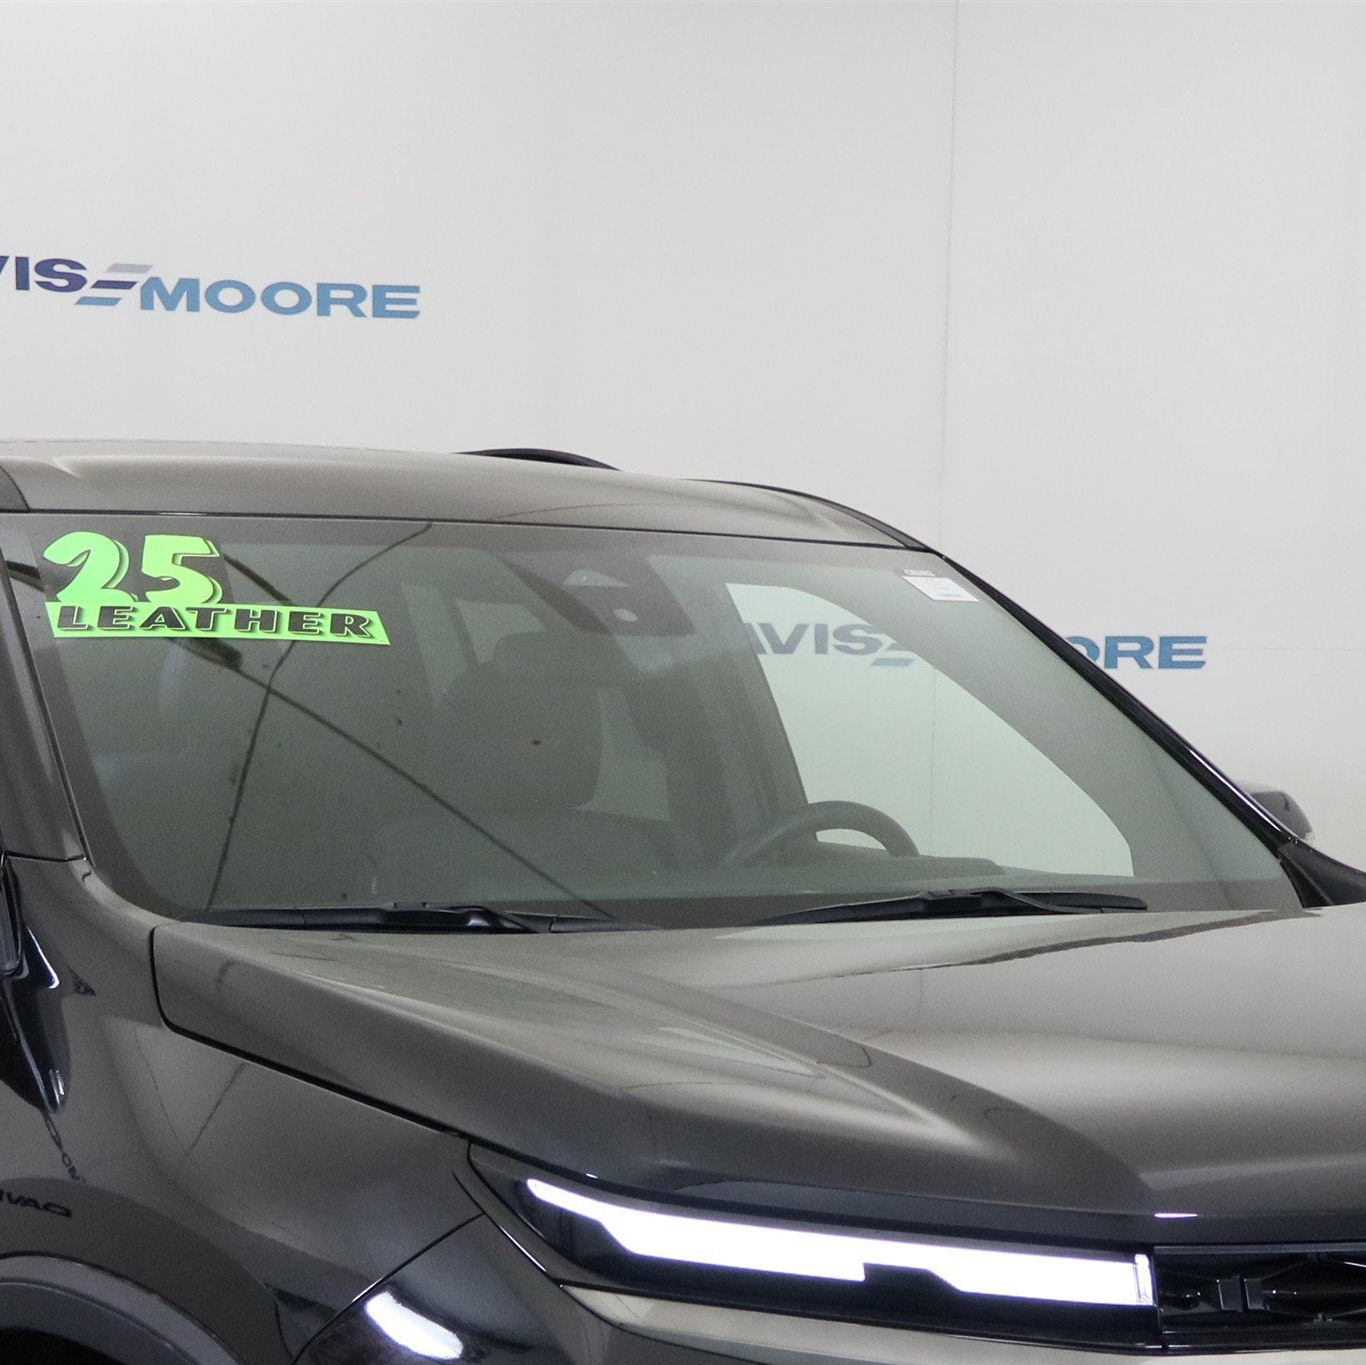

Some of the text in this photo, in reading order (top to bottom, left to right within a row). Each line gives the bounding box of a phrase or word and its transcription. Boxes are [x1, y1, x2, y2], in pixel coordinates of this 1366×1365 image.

[139, 276, 422, 319] MOORE
[43, 531, 223, 603] 25
[57, 604, 375, 638] LEATHER
